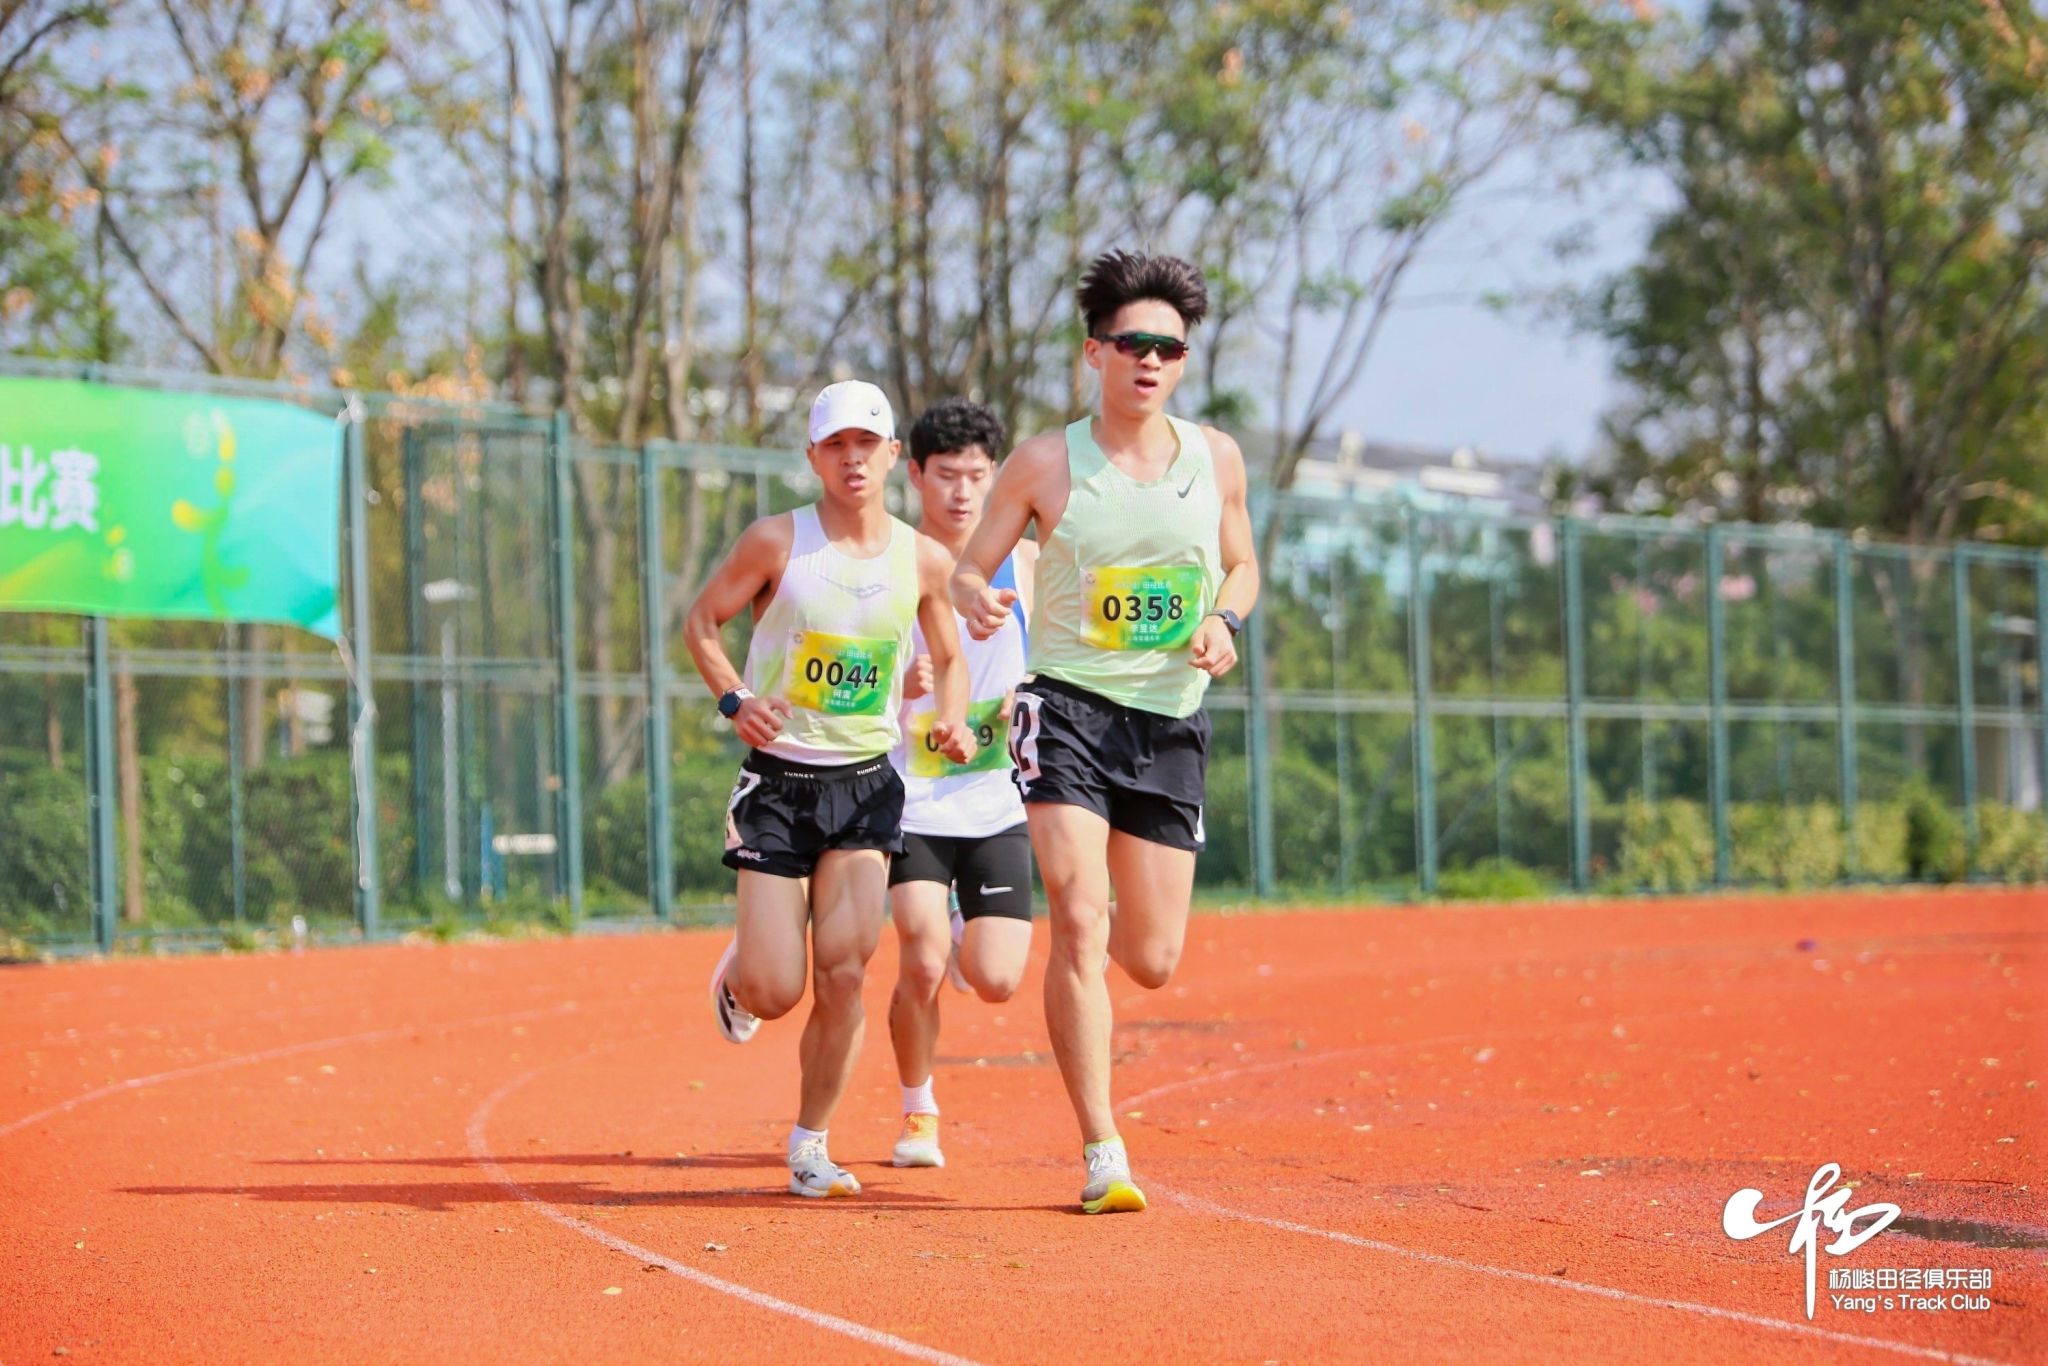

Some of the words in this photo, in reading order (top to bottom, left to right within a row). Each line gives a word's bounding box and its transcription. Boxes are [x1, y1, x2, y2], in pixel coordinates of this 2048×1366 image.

[0, 444, 98, 532] 比赛
[1102, 594, 1183, 622] 0358
[805, 657, 879, 689] 0044
[925, 723, 993, 752] 09
[1012, 701, 1032, 772] 2
